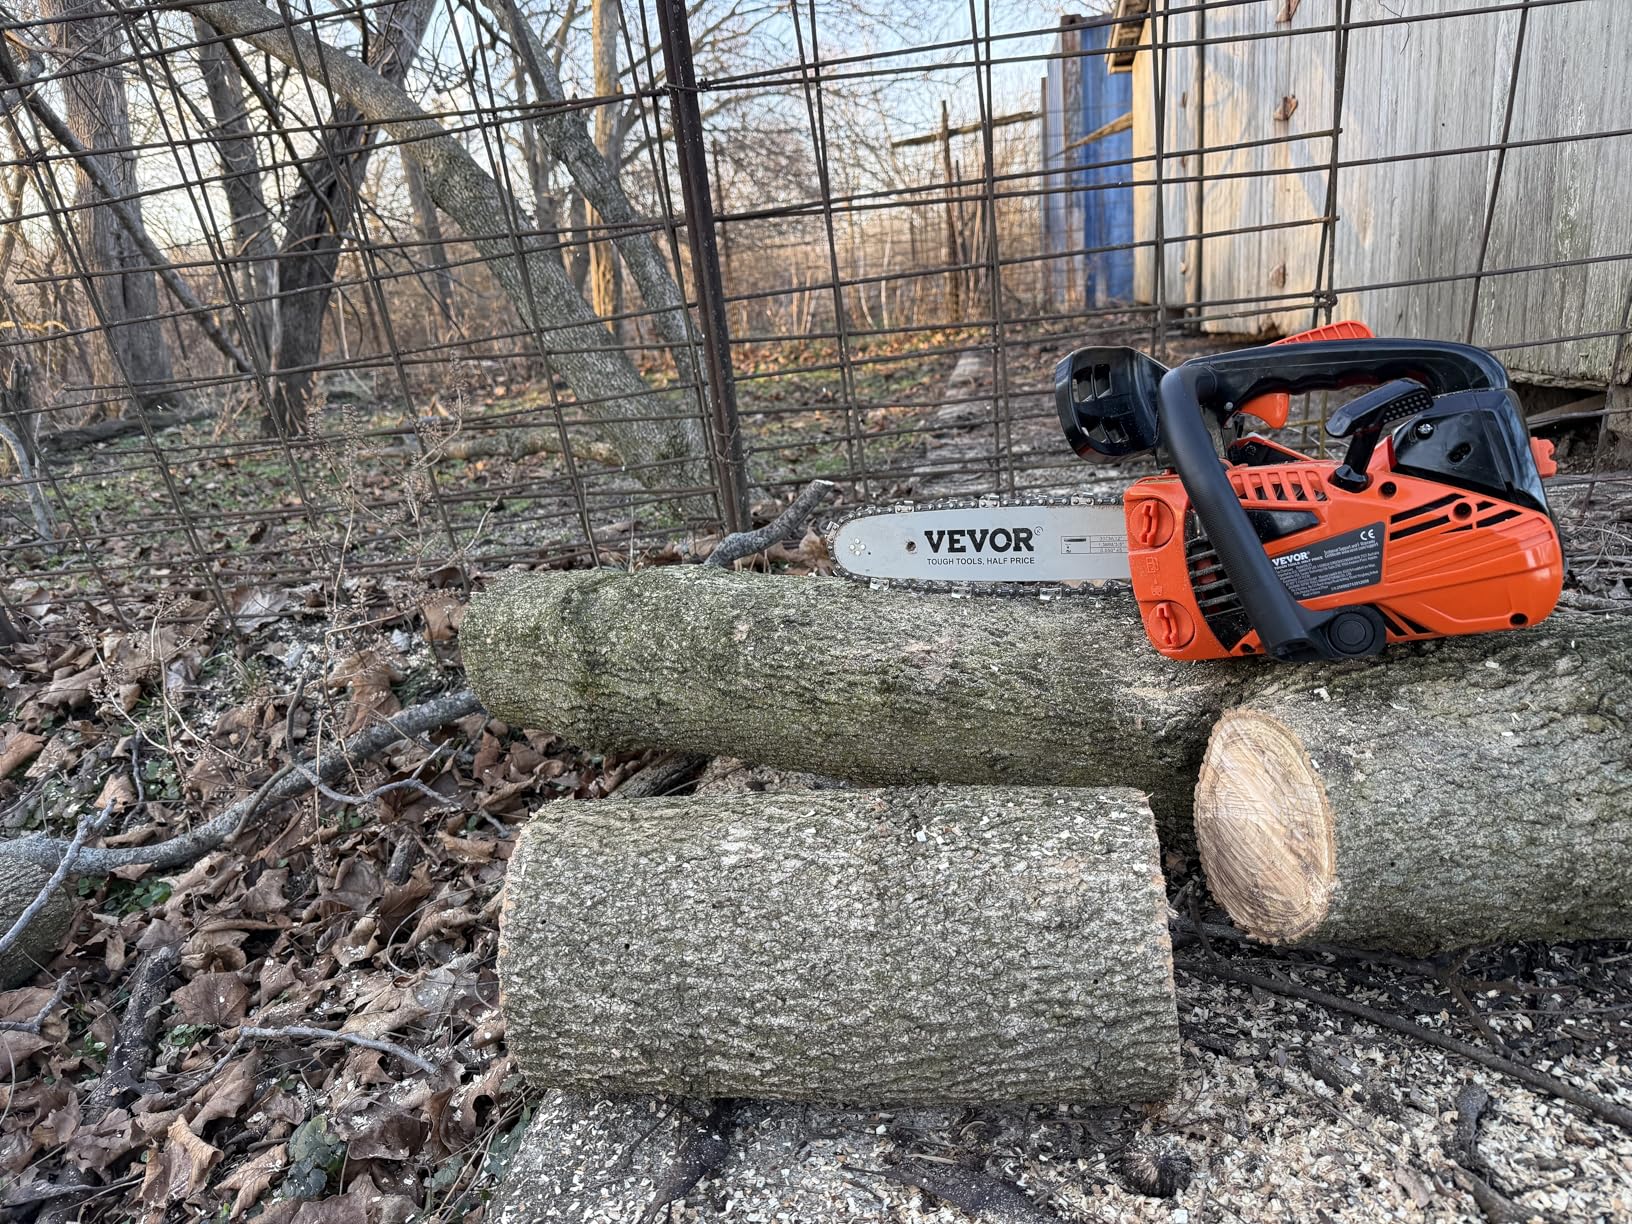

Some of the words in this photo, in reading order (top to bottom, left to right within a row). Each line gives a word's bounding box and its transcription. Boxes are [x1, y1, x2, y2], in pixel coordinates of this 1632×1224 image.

[924, 527, 1035, 553] VEVOR
[927, 557, 954, 566] TOUGH
[956, 557, 985, 566] TOOLS,
[986, 557, 1008, 565] HALF
[1010, 556, 1035, 565] PRICE
[1271, 551, 1308, 566] VEVOR
